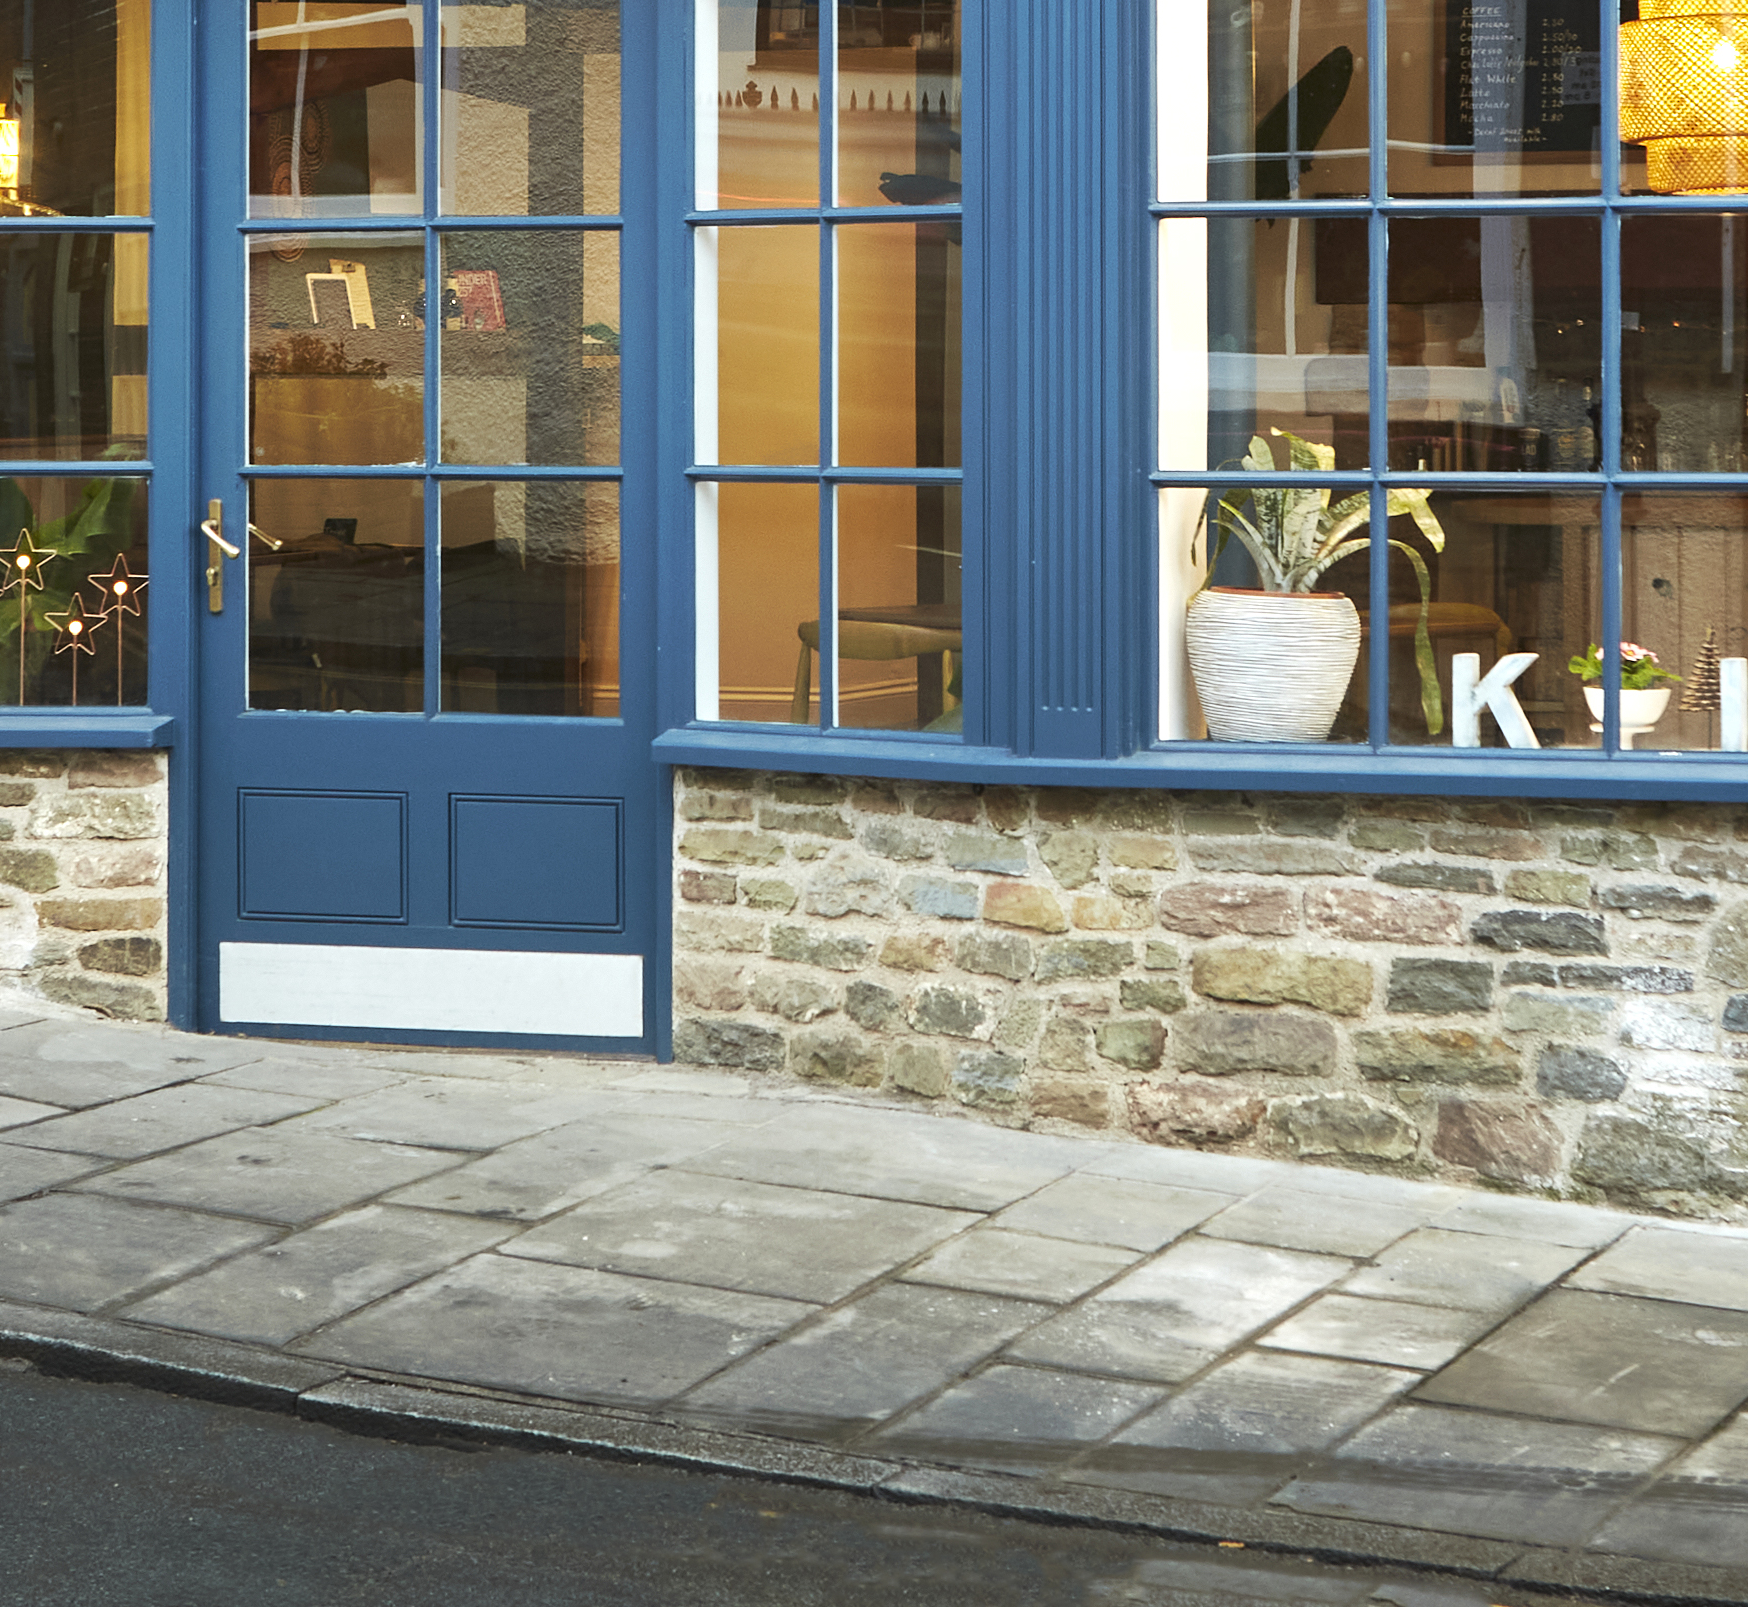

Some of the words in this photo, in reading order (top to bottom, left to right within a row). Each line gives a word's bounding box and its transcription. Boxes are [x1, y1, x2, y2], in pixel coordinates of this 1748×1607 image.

[1461, 6, 1502, 15] COFFEE
[1459, 19, 1510, 29] Americano
[1460, 46, 1503, 58] Espresso
[1459, 113, 1494, 122] Mocha
